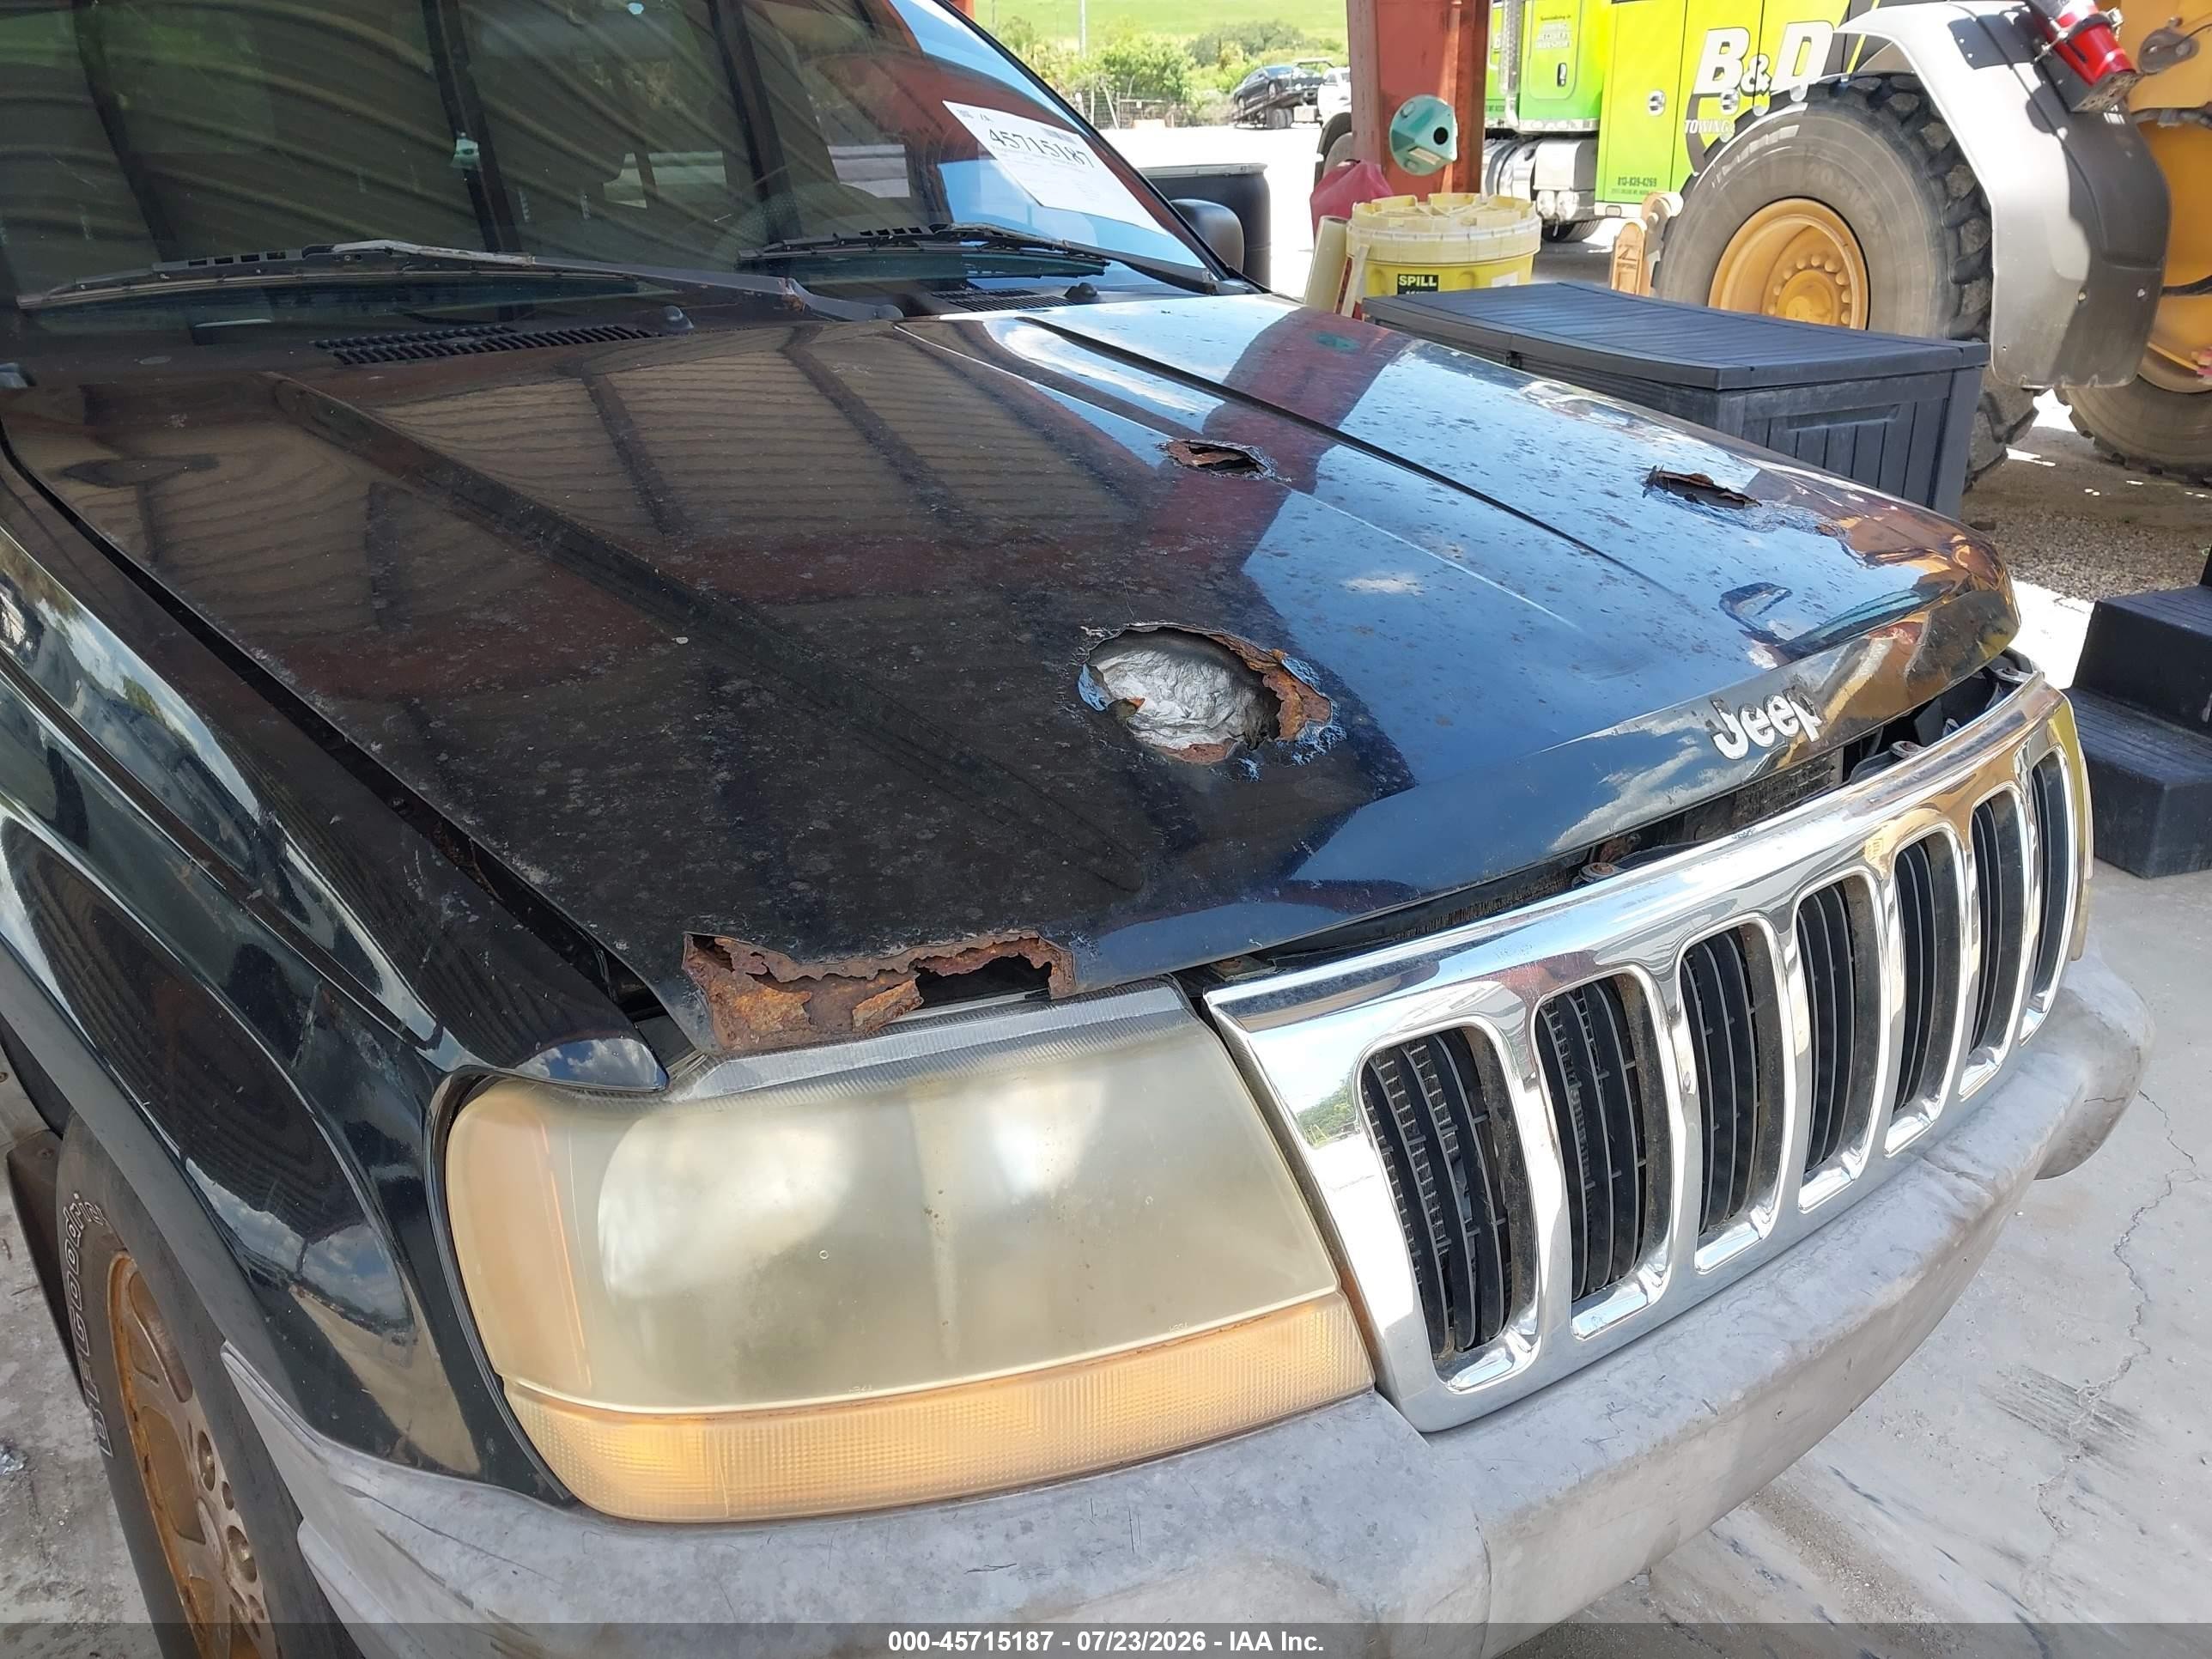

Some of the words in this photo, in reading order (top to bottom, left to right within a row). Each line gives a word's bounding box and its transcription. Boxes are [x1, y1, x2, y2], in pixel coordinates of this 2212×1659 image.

[1692, 21, 1835, 98] B&D
[1684, 118, 1729, 134] TOWING
[988, 128, 1095, 168] 45715187
[1398, 275, 1437, 287] SPILL
[1708, 685, 1823, 760] Jeep
